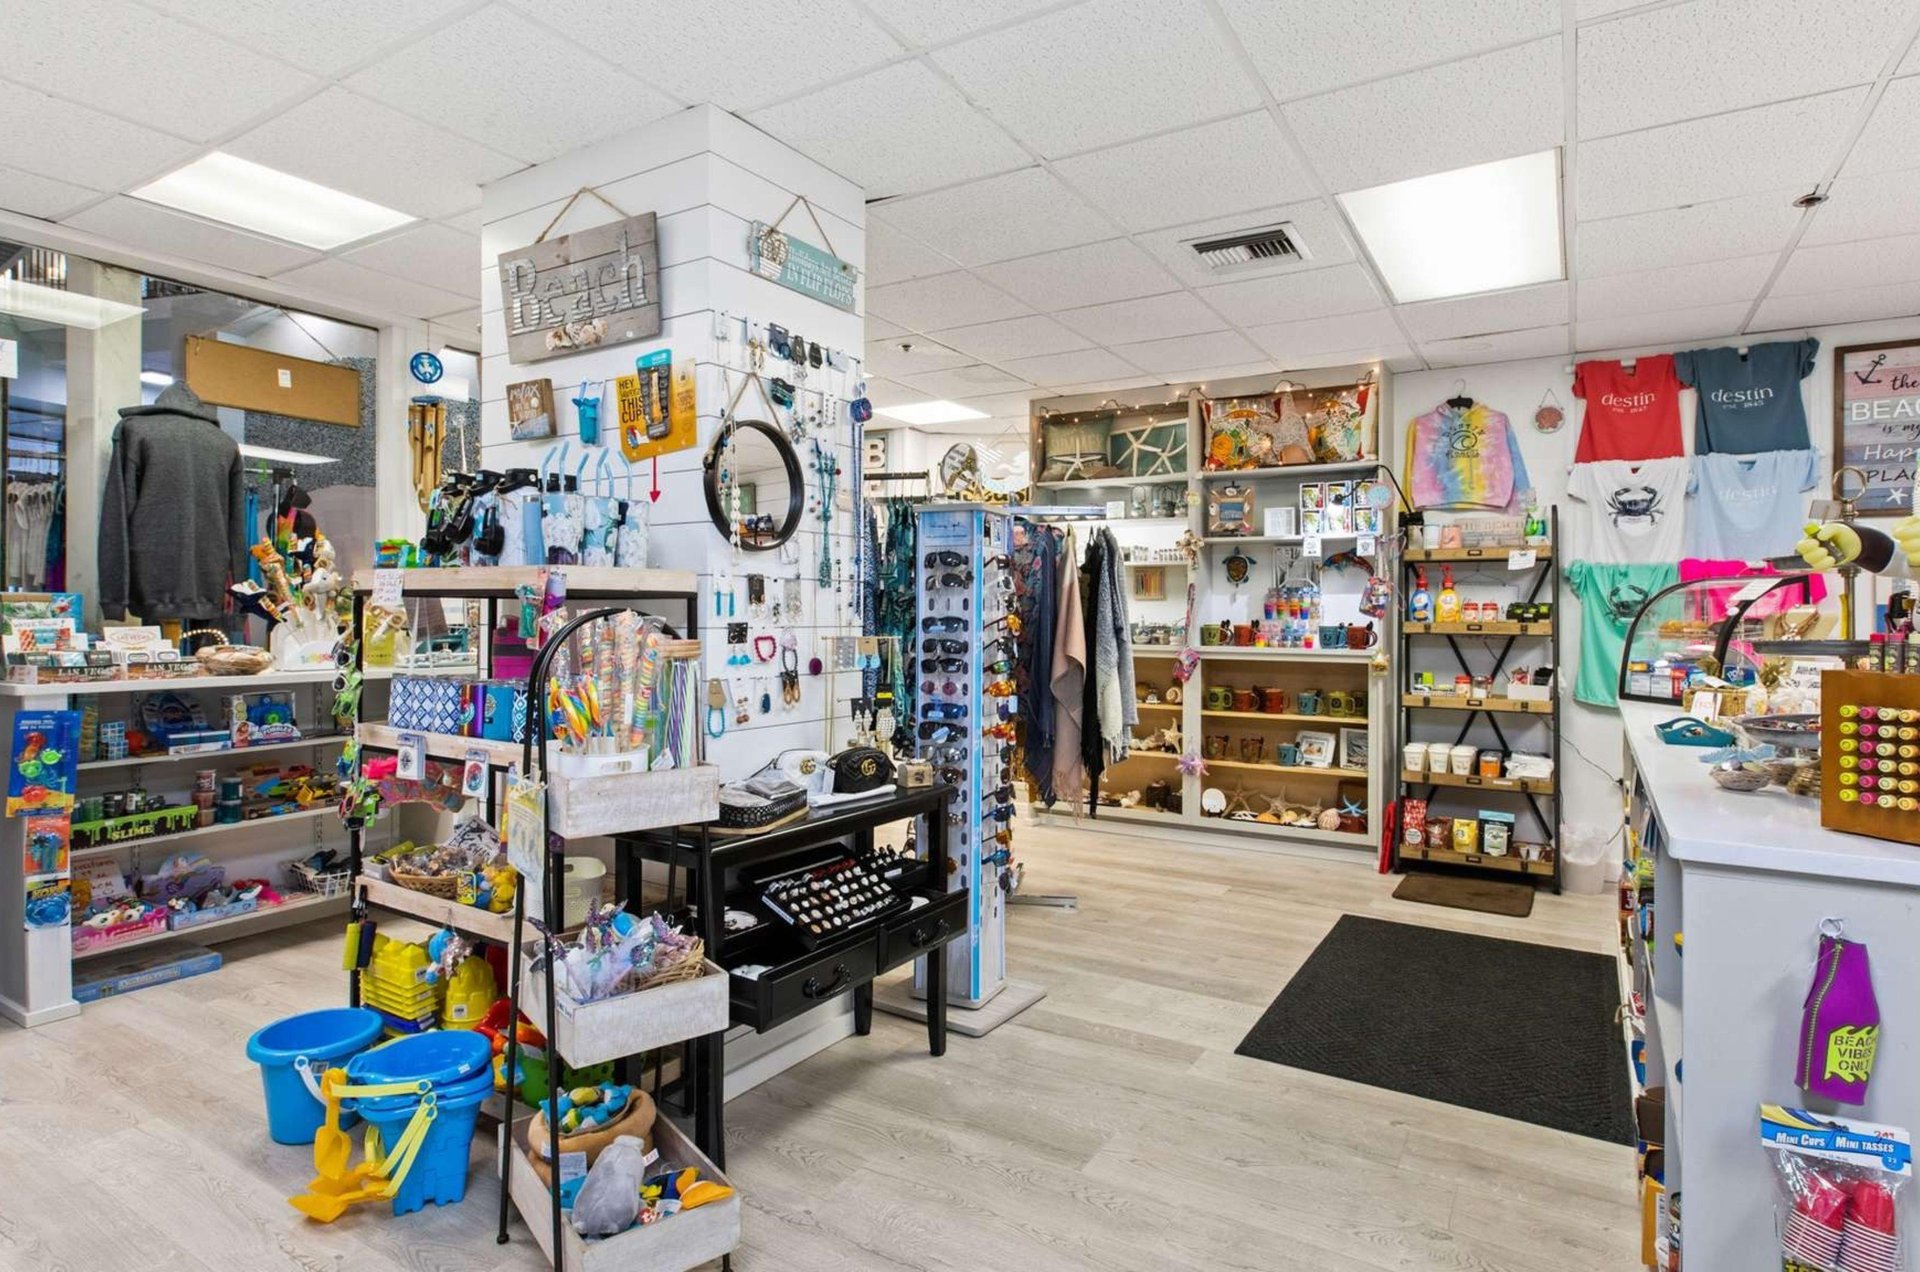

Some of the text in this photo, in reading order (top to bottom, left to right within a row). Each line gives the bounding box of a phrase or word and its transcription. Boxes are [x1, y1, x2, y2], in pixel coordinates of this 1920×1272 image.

[503, 229, 651, 335] Beach
[800, 269, 822, 292] FLIP
[823, 277, 853, 305] FLOPS
[618, 378, 634, 390] HEY
[1891, 373, 1920, 391] the
[621, 396, 643, 411] THIS
[1601, 391, 1656, 408] destin
[1711, 386, 1774, 404] destin
[1851, 398, 1920, 421] BEA
[1863, 444, 1916, 462] Hap
[1867, 469, 1916, 482] PLA
[112, 825, 155, 840] SLIME
[1862, 1141, 1895, 1153] TASSES
